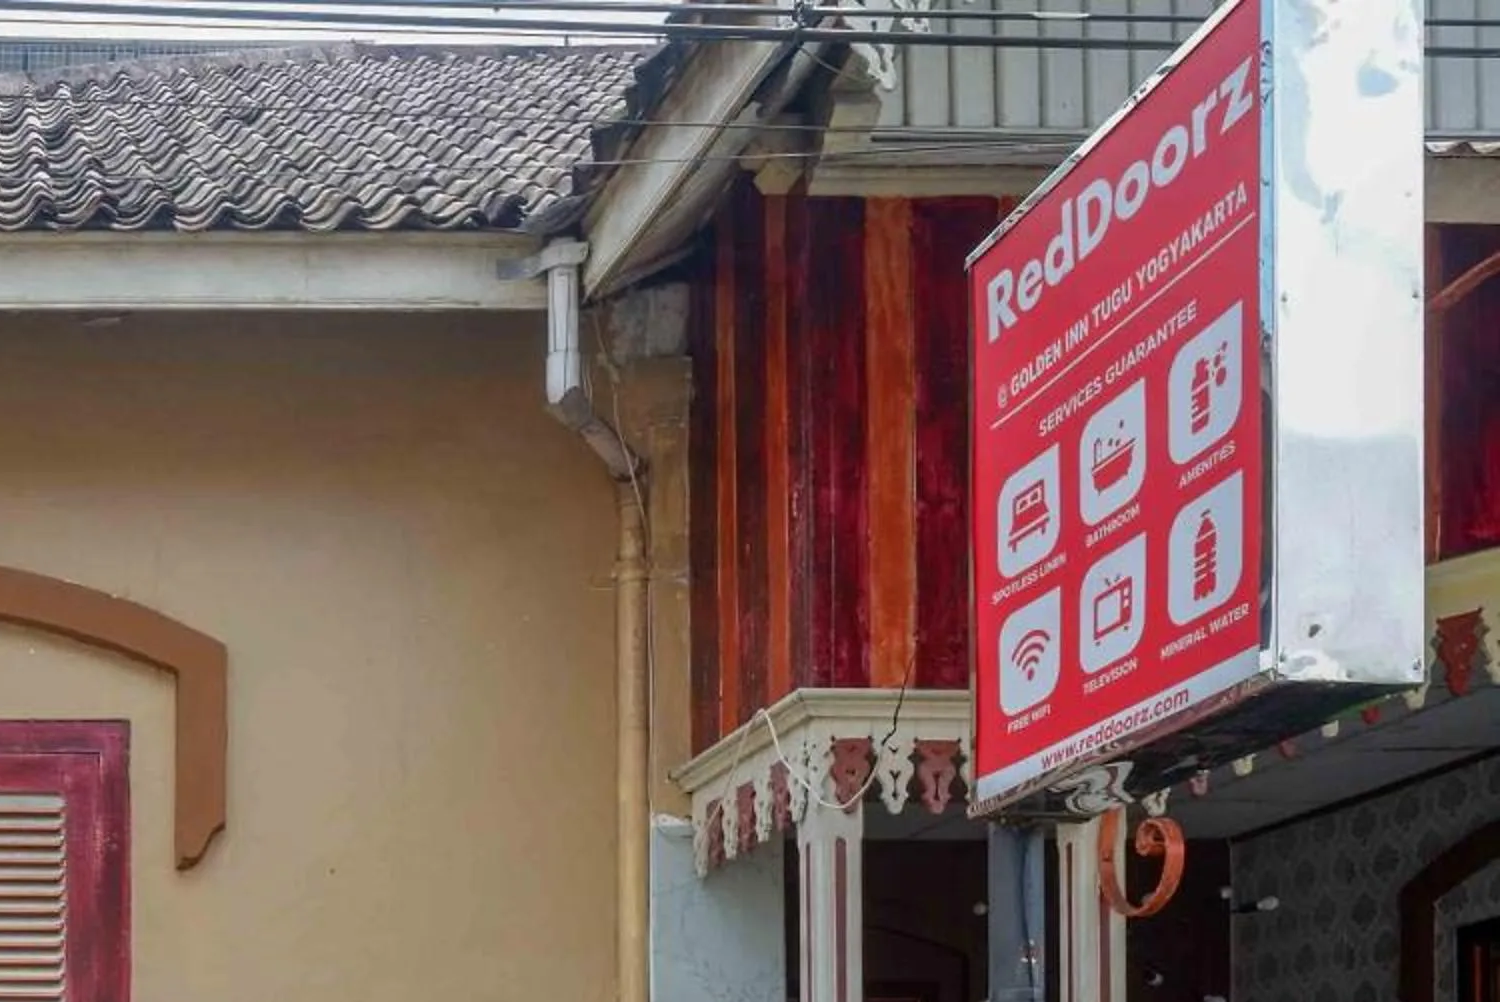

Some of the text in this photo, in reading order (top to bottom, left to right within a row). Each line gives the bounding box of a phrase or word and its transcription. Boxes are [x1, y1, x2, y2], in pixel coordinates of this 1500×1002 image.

[986, 55, 1254, 343] RedDoorz
[1010, 342, 1063, 398] GOLDEN
[1064, 314, 1090, 352] INN
[1091, 278, 1133, 329] TUGU
[1135, 181, 1248, 291] YOGYAKARTA
[1038, 299, 1198, 437] SERVICES GUARANTEE
[1178, 441, 1237, 489] AMENITIES
[1084, 504, 1141, 548] BATHROOM
[991, 551, 1067, 606] SPOTLESS LINEN
[1160, 602, 1250, 661] MINERAL WATER
[1082, 657, 1138, 696] TELEVISION
[1007, 703, 1051, 735] FREE WIFI
[1040, 687, 1190, 771] www.reddoorz.com
